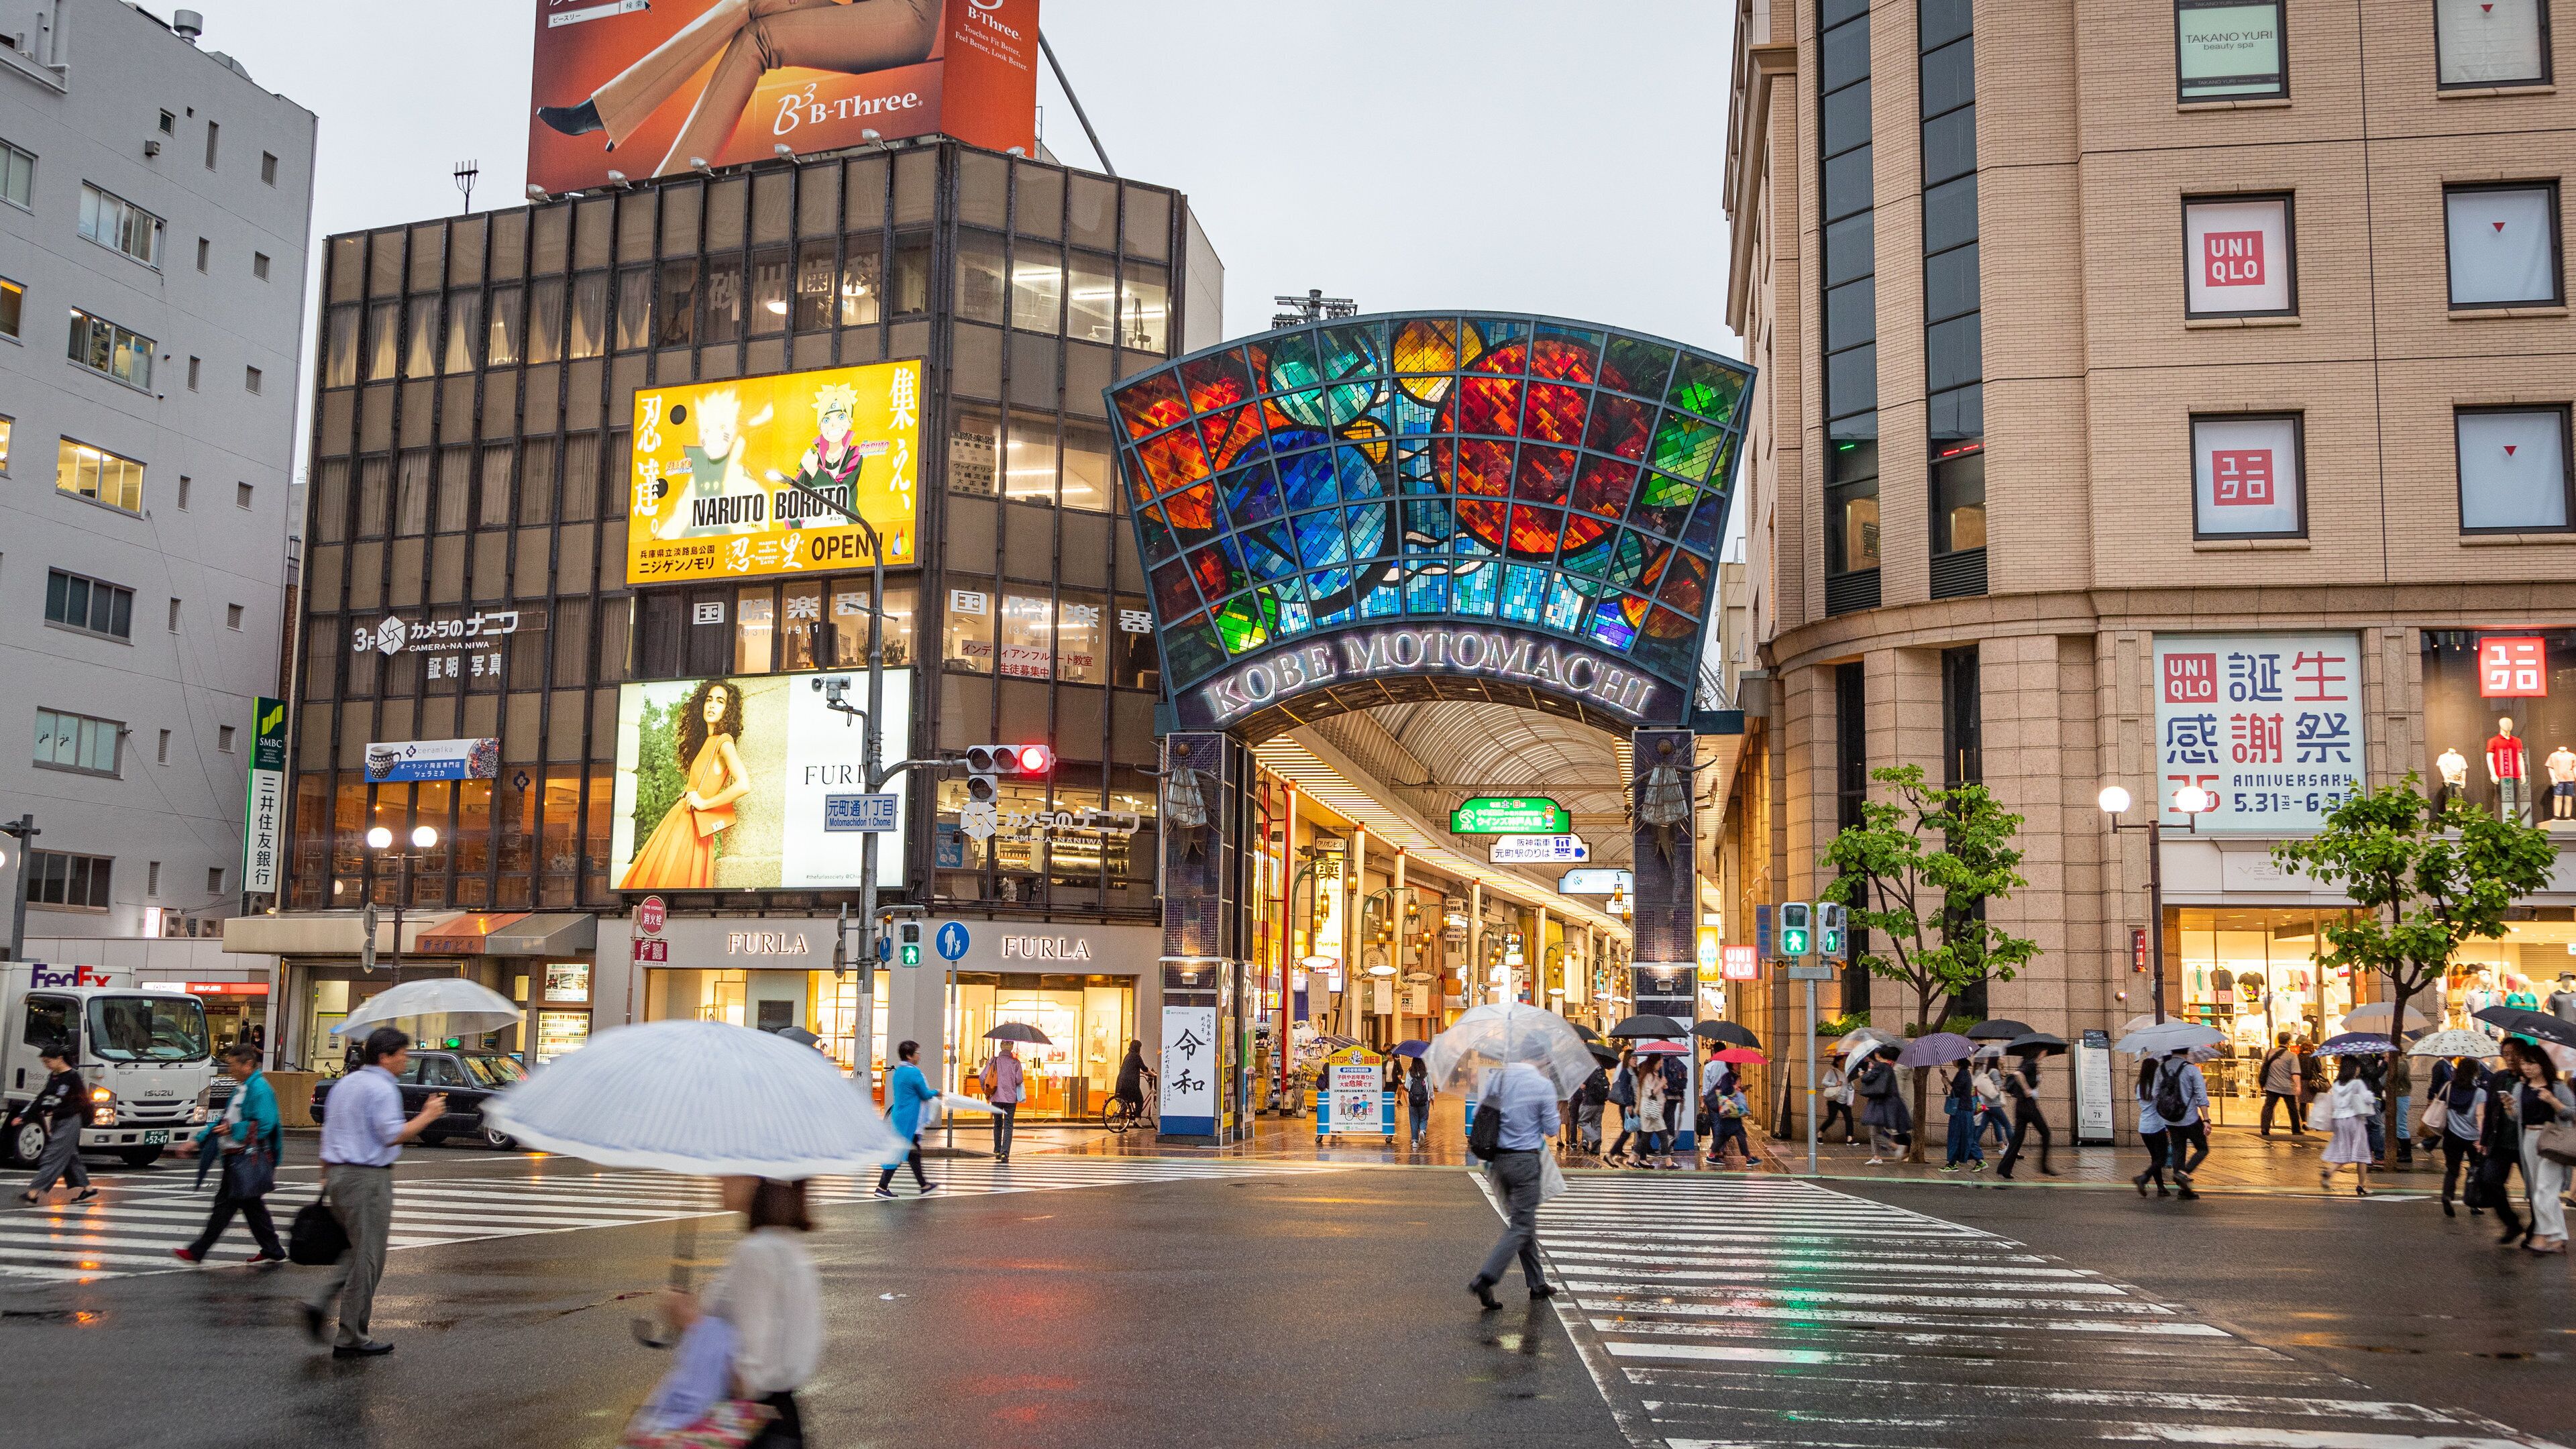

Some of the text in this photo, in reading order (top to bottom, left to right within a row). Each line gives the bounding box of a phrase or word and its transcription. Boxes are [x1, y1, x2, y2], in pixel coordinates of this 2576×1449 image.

[553, 13, 581, 23] ビースリー
[968, 6, 1019, 40] B-Three
[964, 23, 1021, 58] Touches Fit Better,
[2186, 31, 2273, 44] TAKANO YURI
[2204, 42, 2254, 51] beauty spa
[955, 31, 1028, 71] Feel Better, Look Better.
[2211, 238, 2253, 257] UNI
[2212, 260, 2257, 282] QLO
[693, 486, 849, 527] NARUTO BORUTO
[640, 545, 715, 559] 兵庫県立淡路島公園
[811, 533, 883, 561] OPEN!
[639, 557, 714, 575] ニジゲンノモリ
[410, 610, 519, 639] カメラのナニワ
[786, 623, 819, 635] 1911
[1203, 631, 1656, 721] KOBE MOTOMACHI
[2170, 659, 2207, 678] UNI
[2228, 651, 2348, 702] 誕生
[2171, 680, 2212, 700] QLO
[260, 737, 282, 748] SMBC
[2166, 712, 2351, 764] 感謝祭
[415, 770, 445, 778] ツェラミカ
[805, 764, 866, 785] FURL
[2233, 774, 2352, 787] ANNIVERSARY
[828, 800, 893, 816] 元町通1丁目
[2235, 793, 2278, 812] 5.31
[829, 817, 891, 827] Motomachidori 1 Chome
[1006, 806, 1140, 835] カメラのナニワ
[256, 776, 275, 885] 三井住友銀行
[1317, 840, 1344, 848] クリオンビル
[1517, 839, 1550, 847] 阪神電車
[643, 912, 662, 926] 消火栓
[727, 933, 808, 954] FURLA
[1003, 936, 1091, 959] FURLA
[1725, 949, 1751, 963] UNI
[30, 963, 112, 988] FedEx
[1726, 963, 1754, 977] QLO
[1172, 1028, 1207, 1095] 令和
[1364, 1056, 1381, 1065] 自転車
[150, 1135, 168, 1144] 52-47
